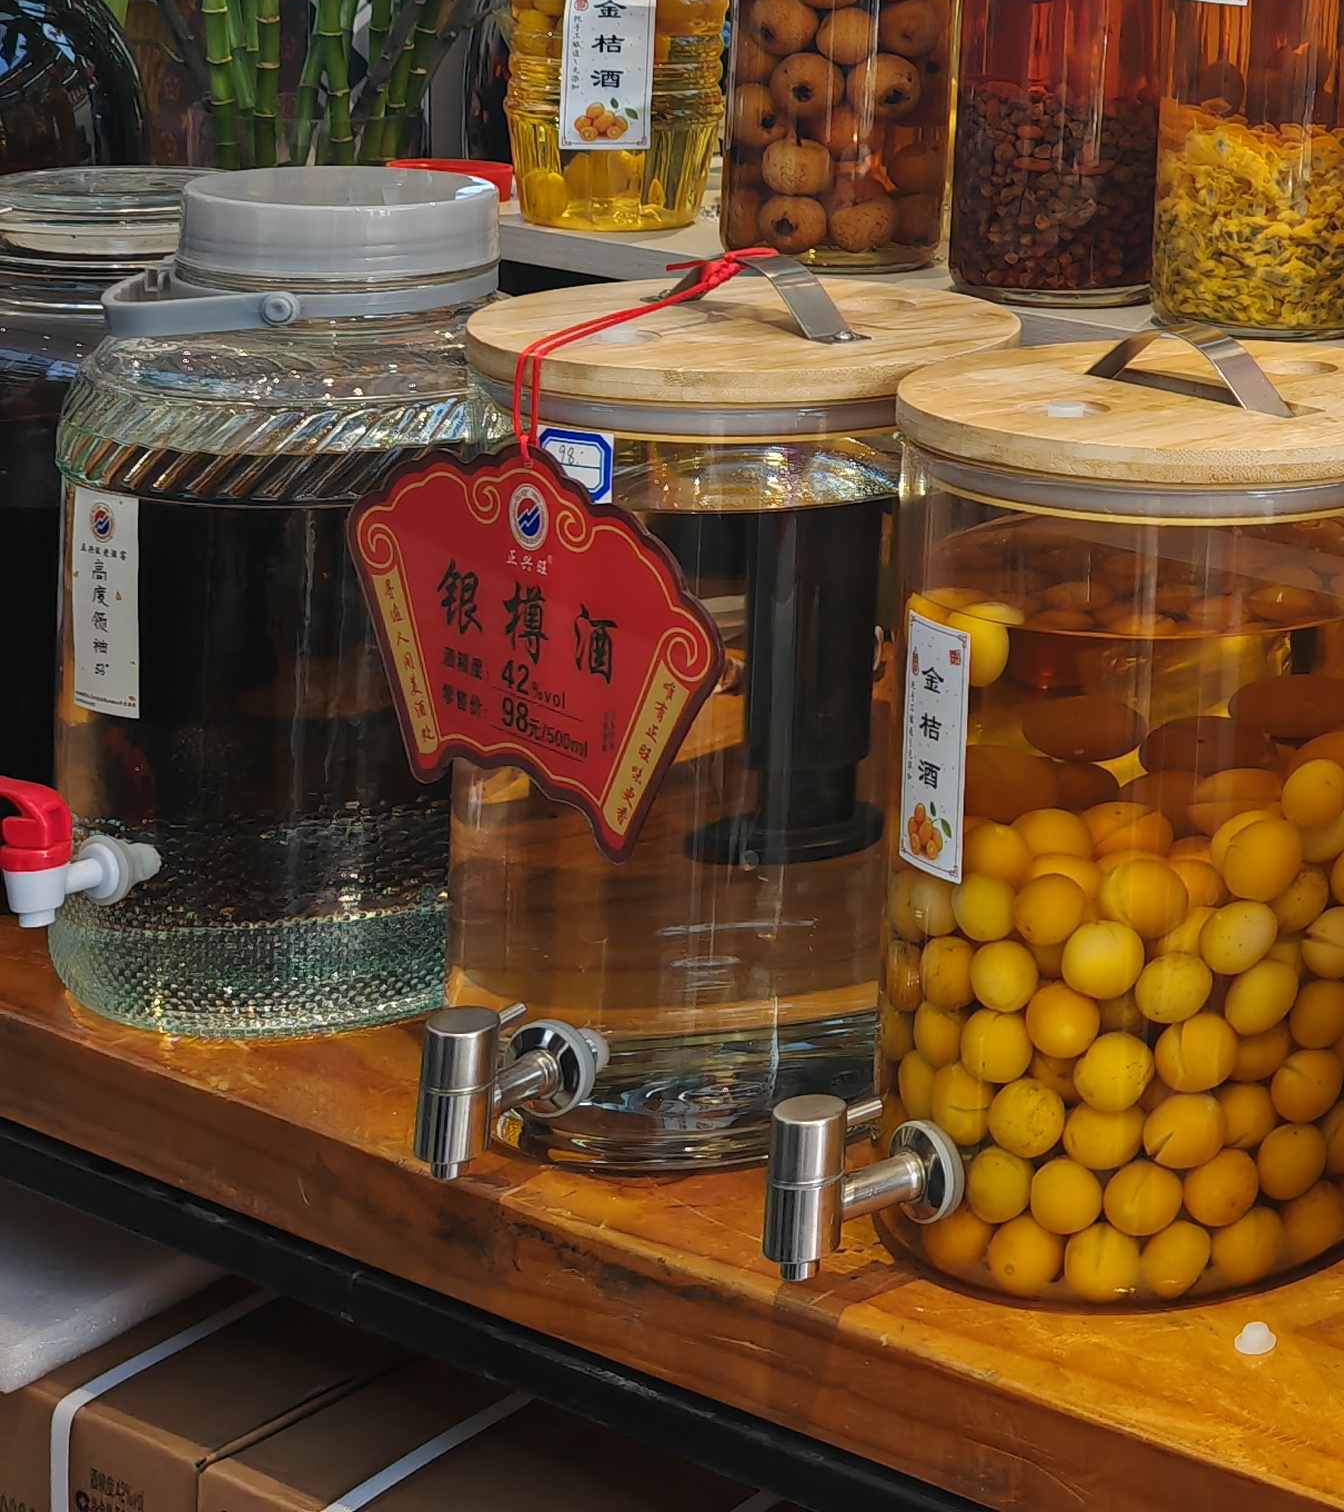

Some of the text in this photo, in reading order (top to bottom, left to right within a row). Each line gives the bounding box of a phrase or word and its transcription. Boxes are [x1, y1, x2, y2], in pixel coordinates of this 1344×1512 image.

[590, 0, 627, 89] 金桔酒
[505, 549, 549, 577] 正兴旺
[437, 556, 618, 685] 银樽酒
[916, 665, 945, 791] 金桔酒
